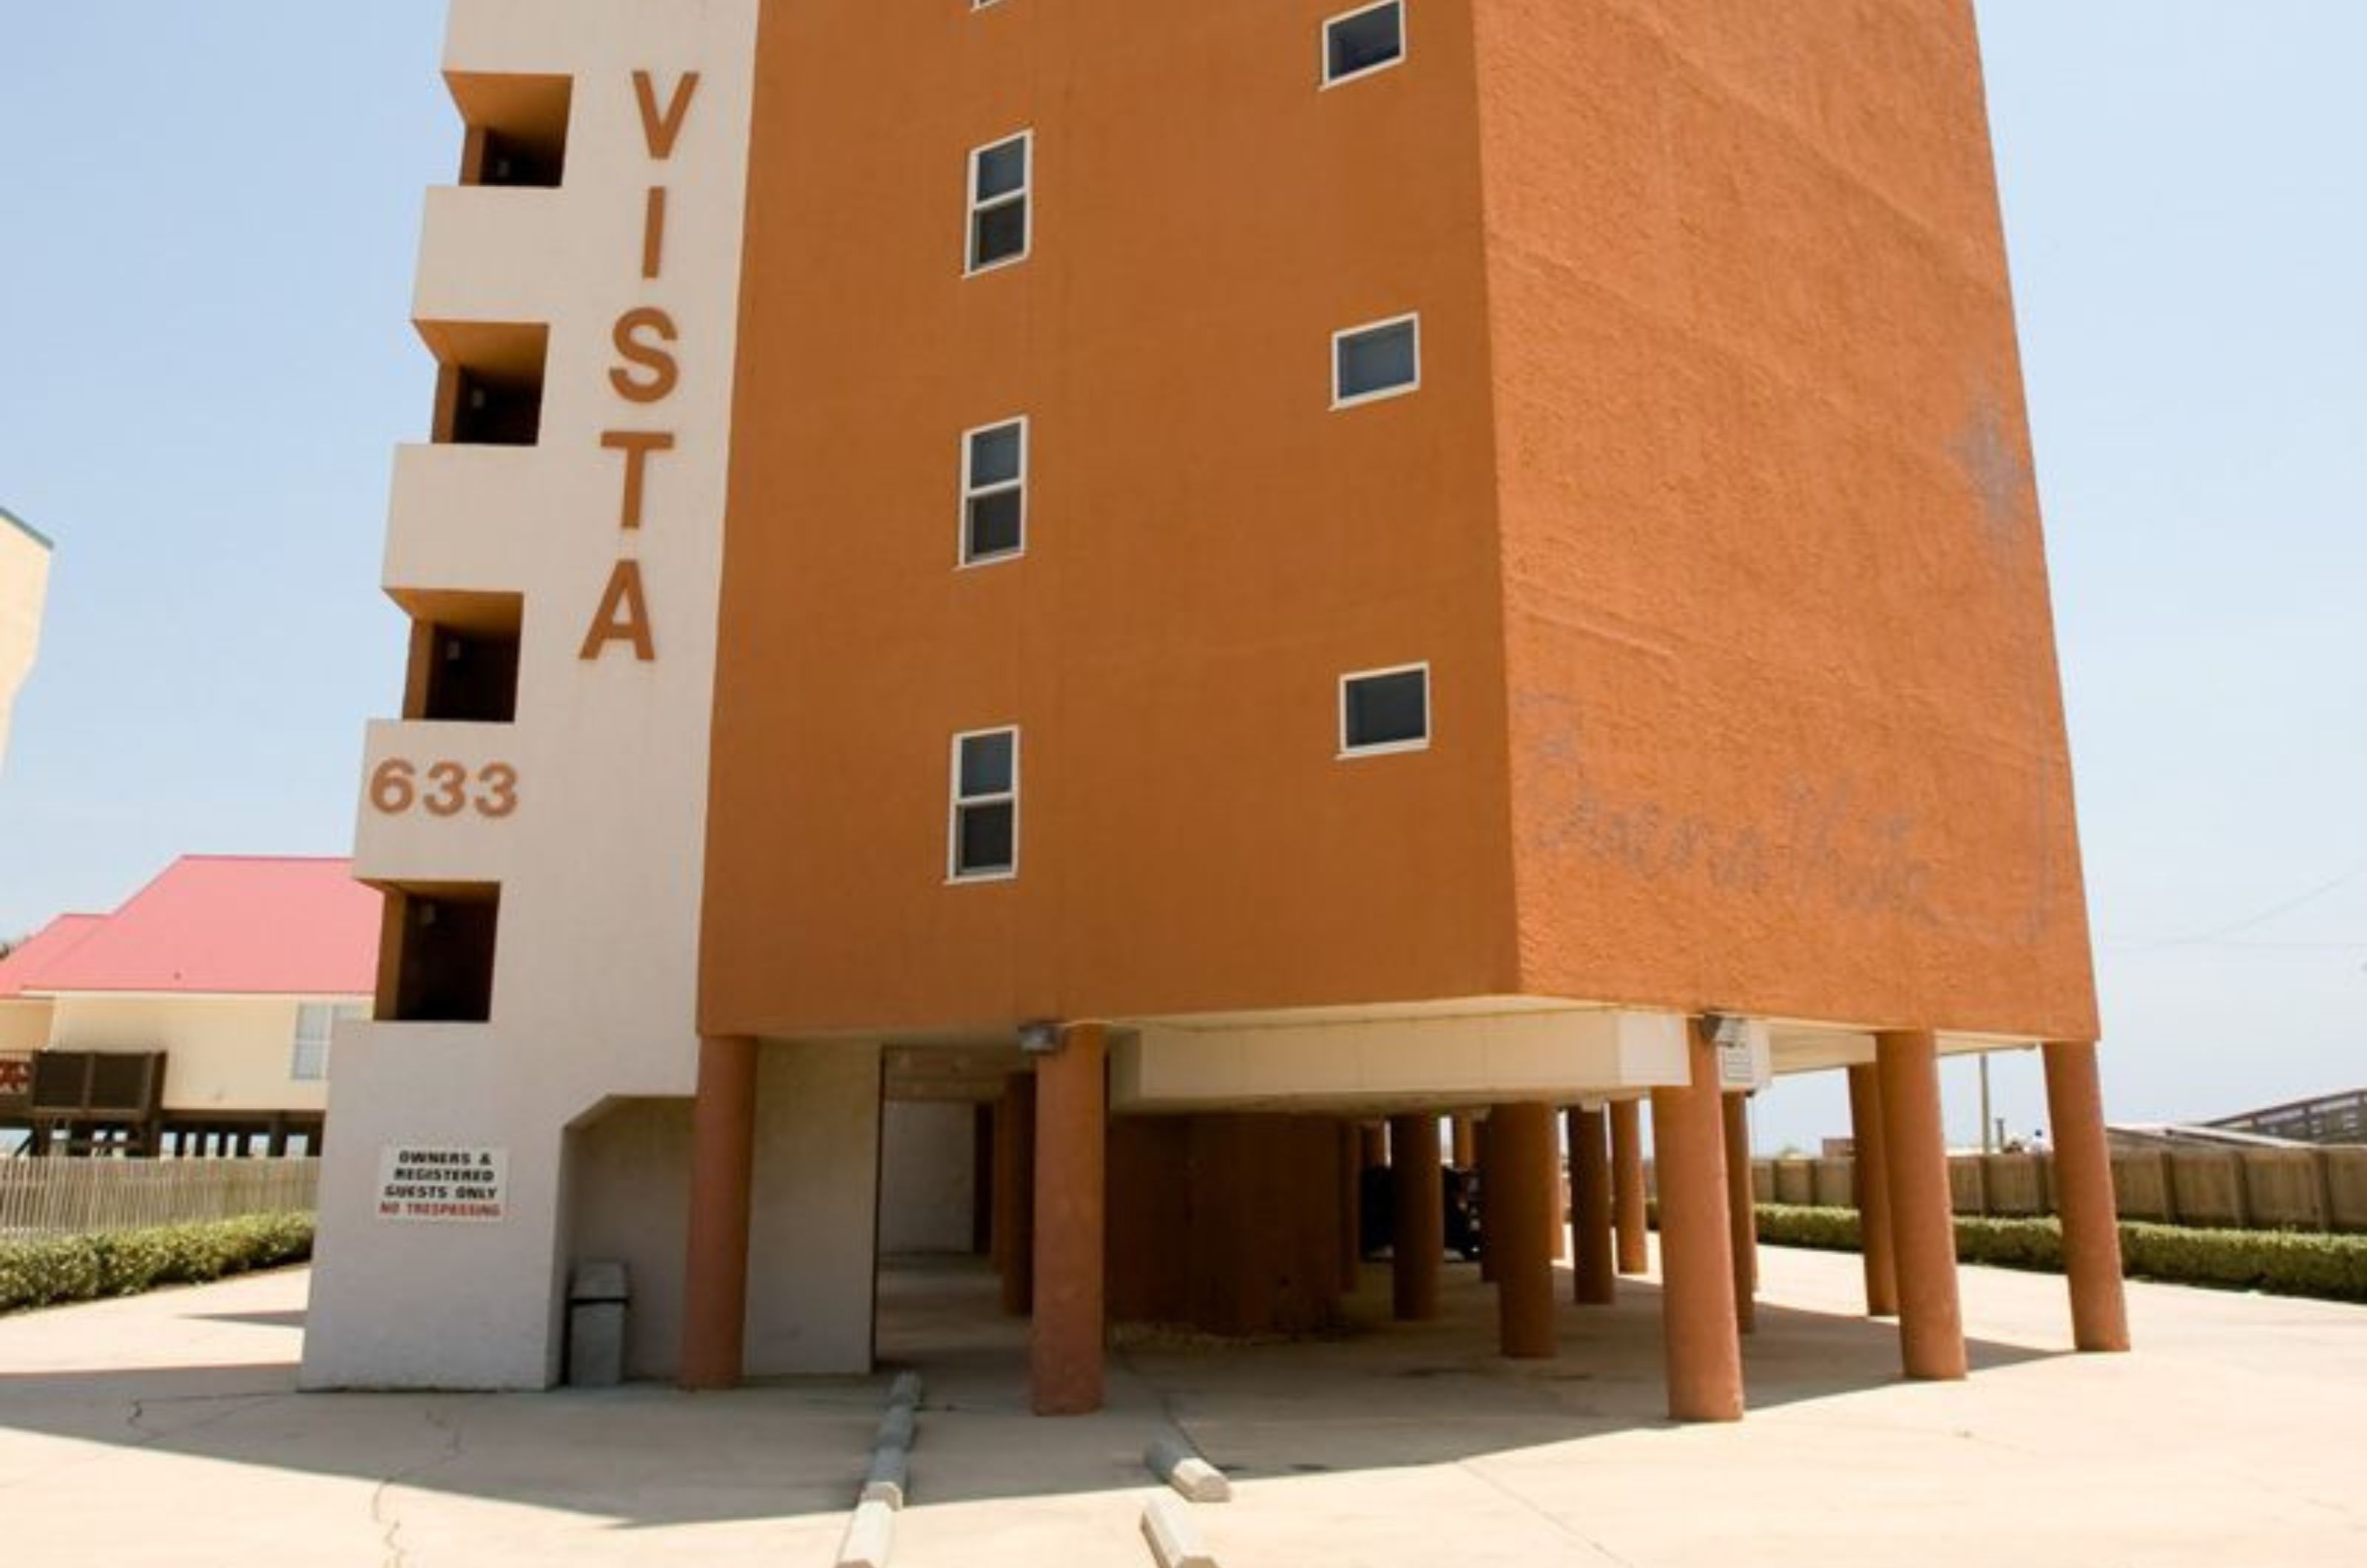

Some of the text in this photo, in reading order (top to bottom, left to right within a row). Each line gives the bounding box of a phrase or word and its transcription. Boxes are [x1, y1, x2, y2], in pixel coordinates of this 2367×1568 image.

[578, 70, 700, 660] VISTA
[371, 757, 517, 817] 633
[399, 1150, 492, 1165] OWNERS &
[394, 1168, 495, 1181] REGISTERED
[385, 1185, 497, 1198] GUESTS ONLY
[379, 1201, 501, 1216] NO TRESPASSING
